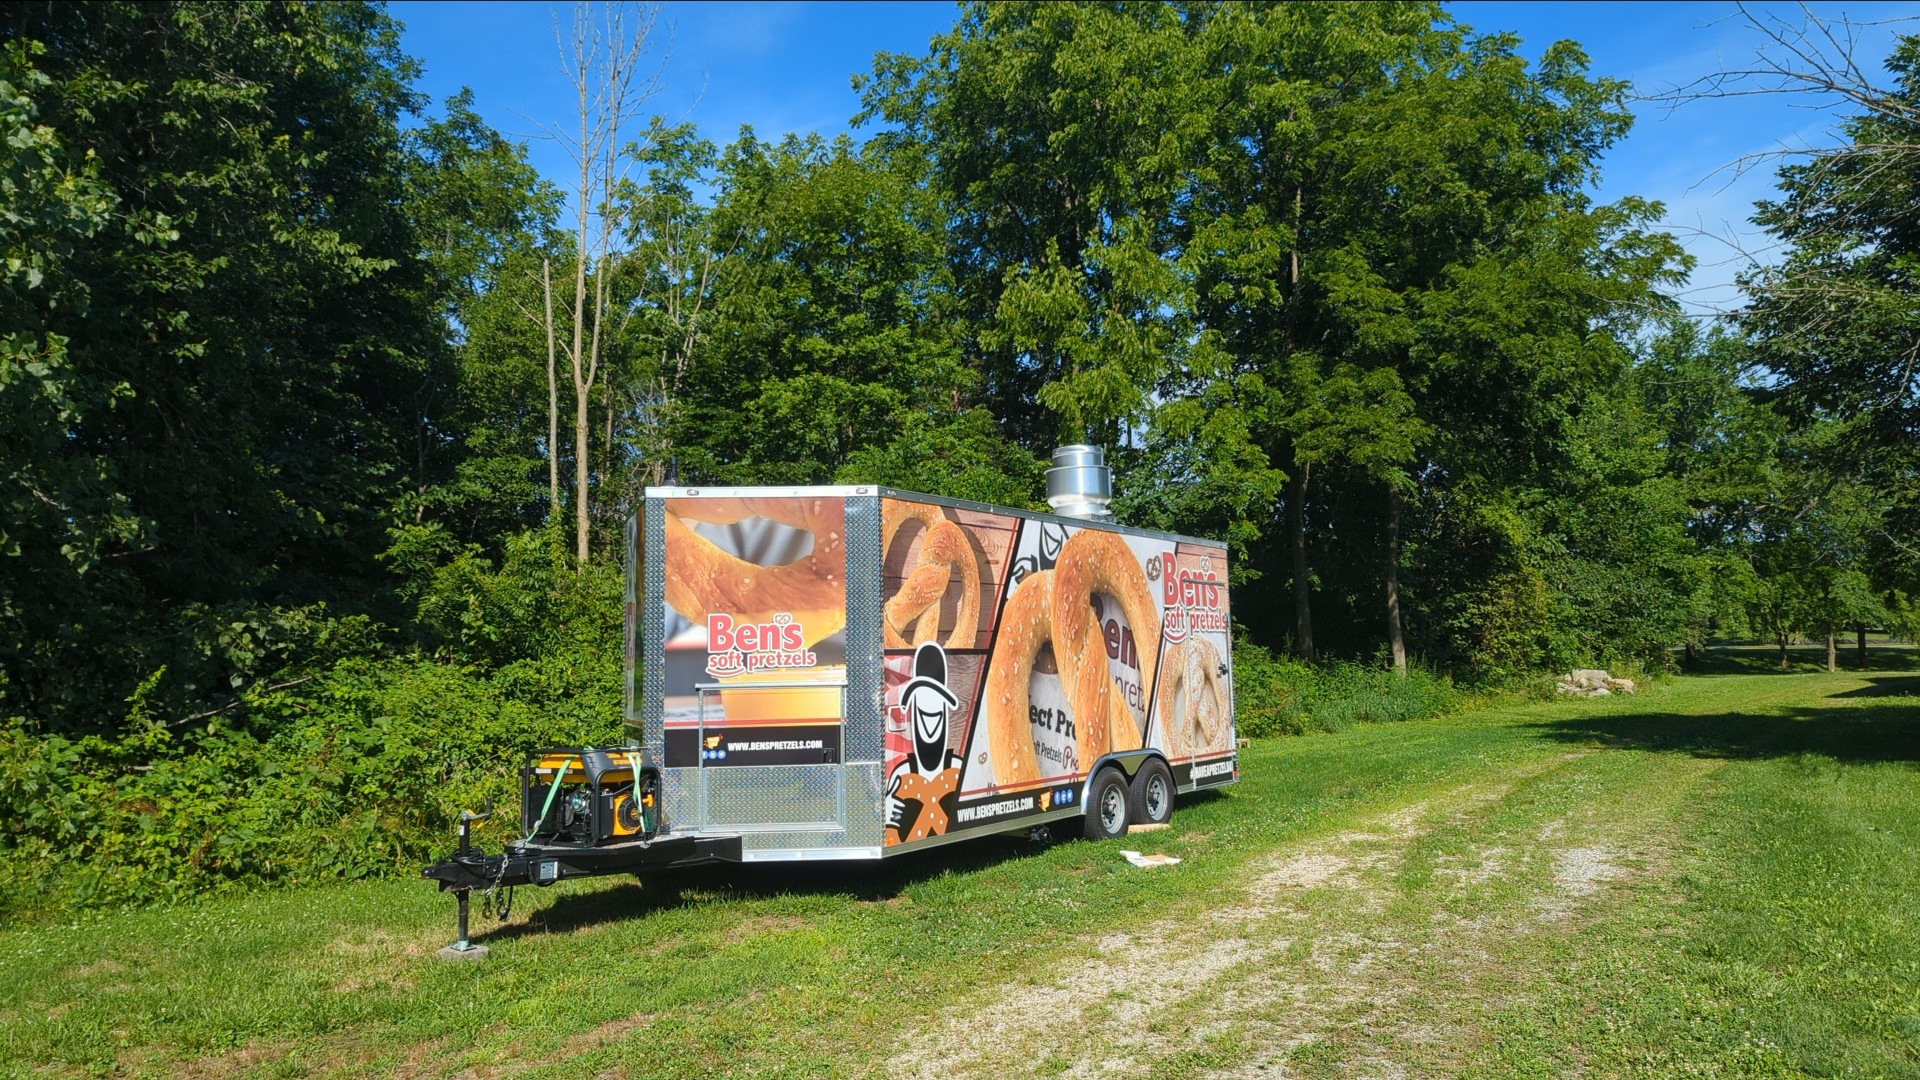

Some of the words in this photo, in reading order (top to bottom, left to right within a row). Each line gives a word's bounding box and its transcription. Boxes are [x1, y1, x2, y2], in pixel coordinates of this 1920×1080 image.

[1164, 606, 1186, 630] soft
[1189, 608, 1229, 638] pretzels
[709, 651, 743, 669] soft
[747, 648, 817, 673] pretzels
[1028, 696, 1053, 731] ect
[727, 740, 823, 752] WWW.BENSPRETZELS.COM
[957, 797, 1034, 823] WWW.BENSPRETZELS.COM
